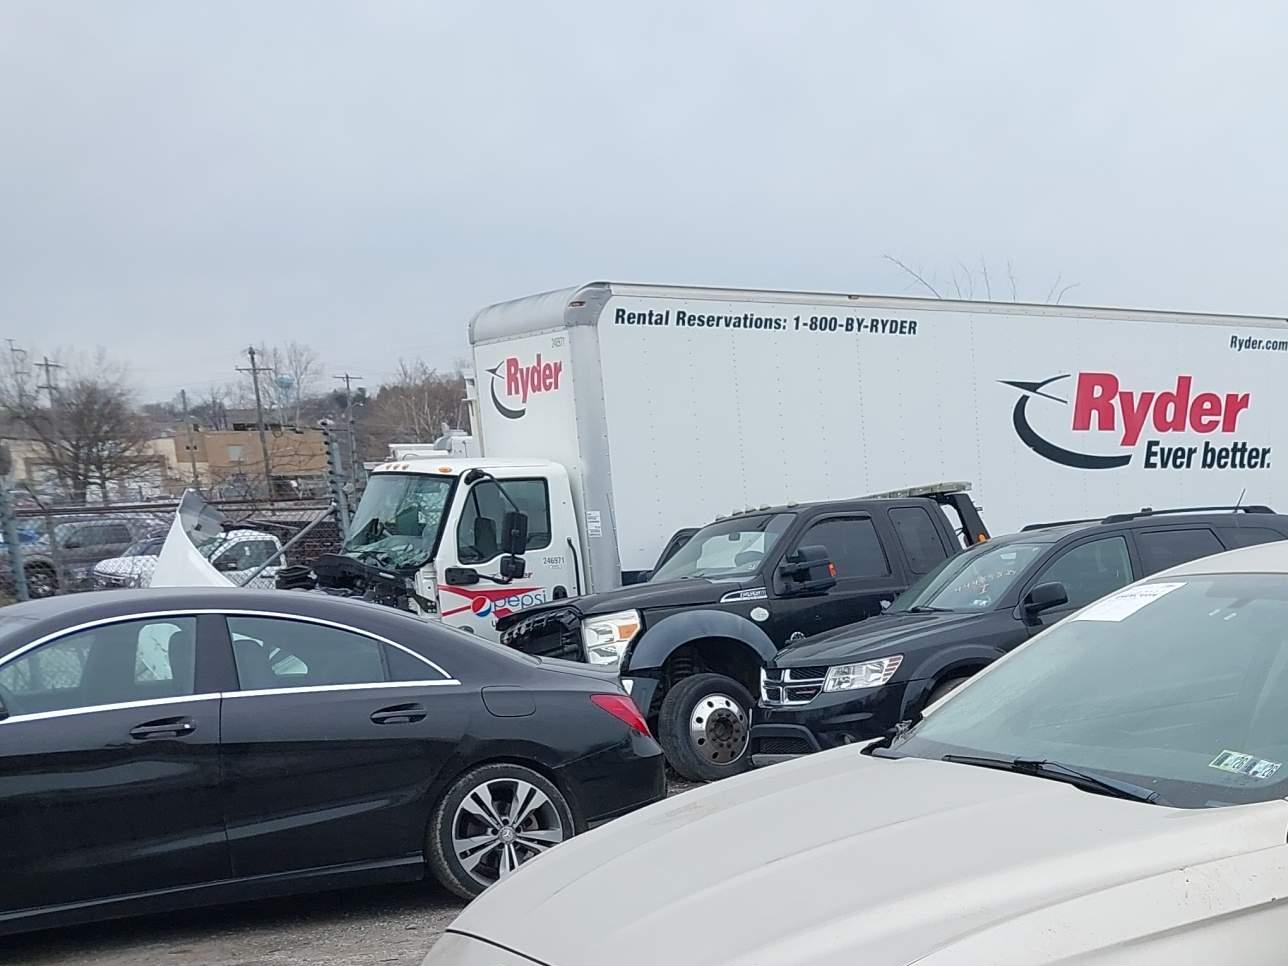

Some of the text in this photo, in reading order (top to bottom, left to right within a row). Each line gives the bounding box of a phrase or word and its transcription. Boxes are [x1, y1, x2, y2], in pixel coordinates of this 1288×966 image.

[613, 308, 918, 335] Rental Reservations: 1-800-BY-RYDER
[1230, 335, 1288, 352] Ryder.com
[506, 353, 563, 404] Ryder
[1072, 372, 1250, 447] Ryder
[1144, 440, 1272, 469] Ever better.
[492, 590, 546, 612] pepsi
